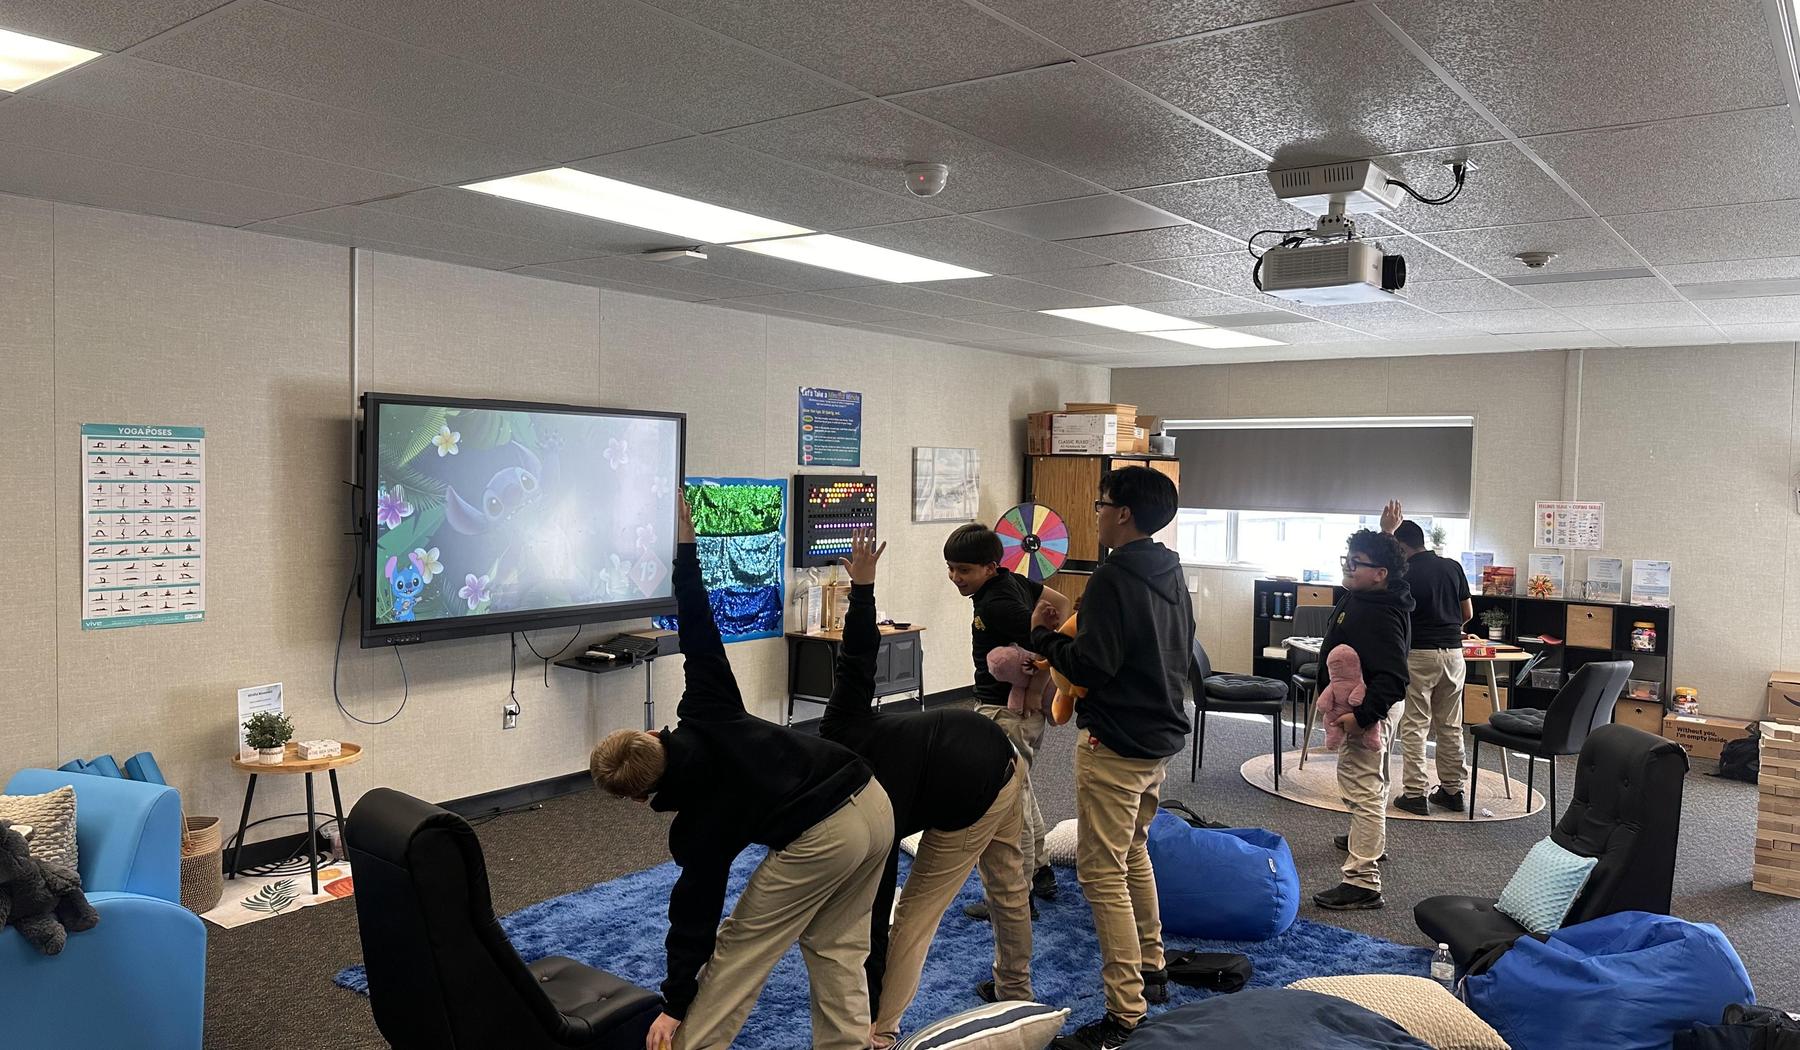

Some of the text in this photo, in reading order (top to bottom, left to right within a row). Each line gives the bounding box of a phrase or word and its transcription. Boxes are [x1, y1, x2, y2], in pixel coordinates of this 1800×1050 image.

[118, 427, 173, 436] YOGA POSES
[640, 561, 657, 582] 19
[1676, 727, 1717, 738] Without you,
[1687, 733, 1708, 742] empty
